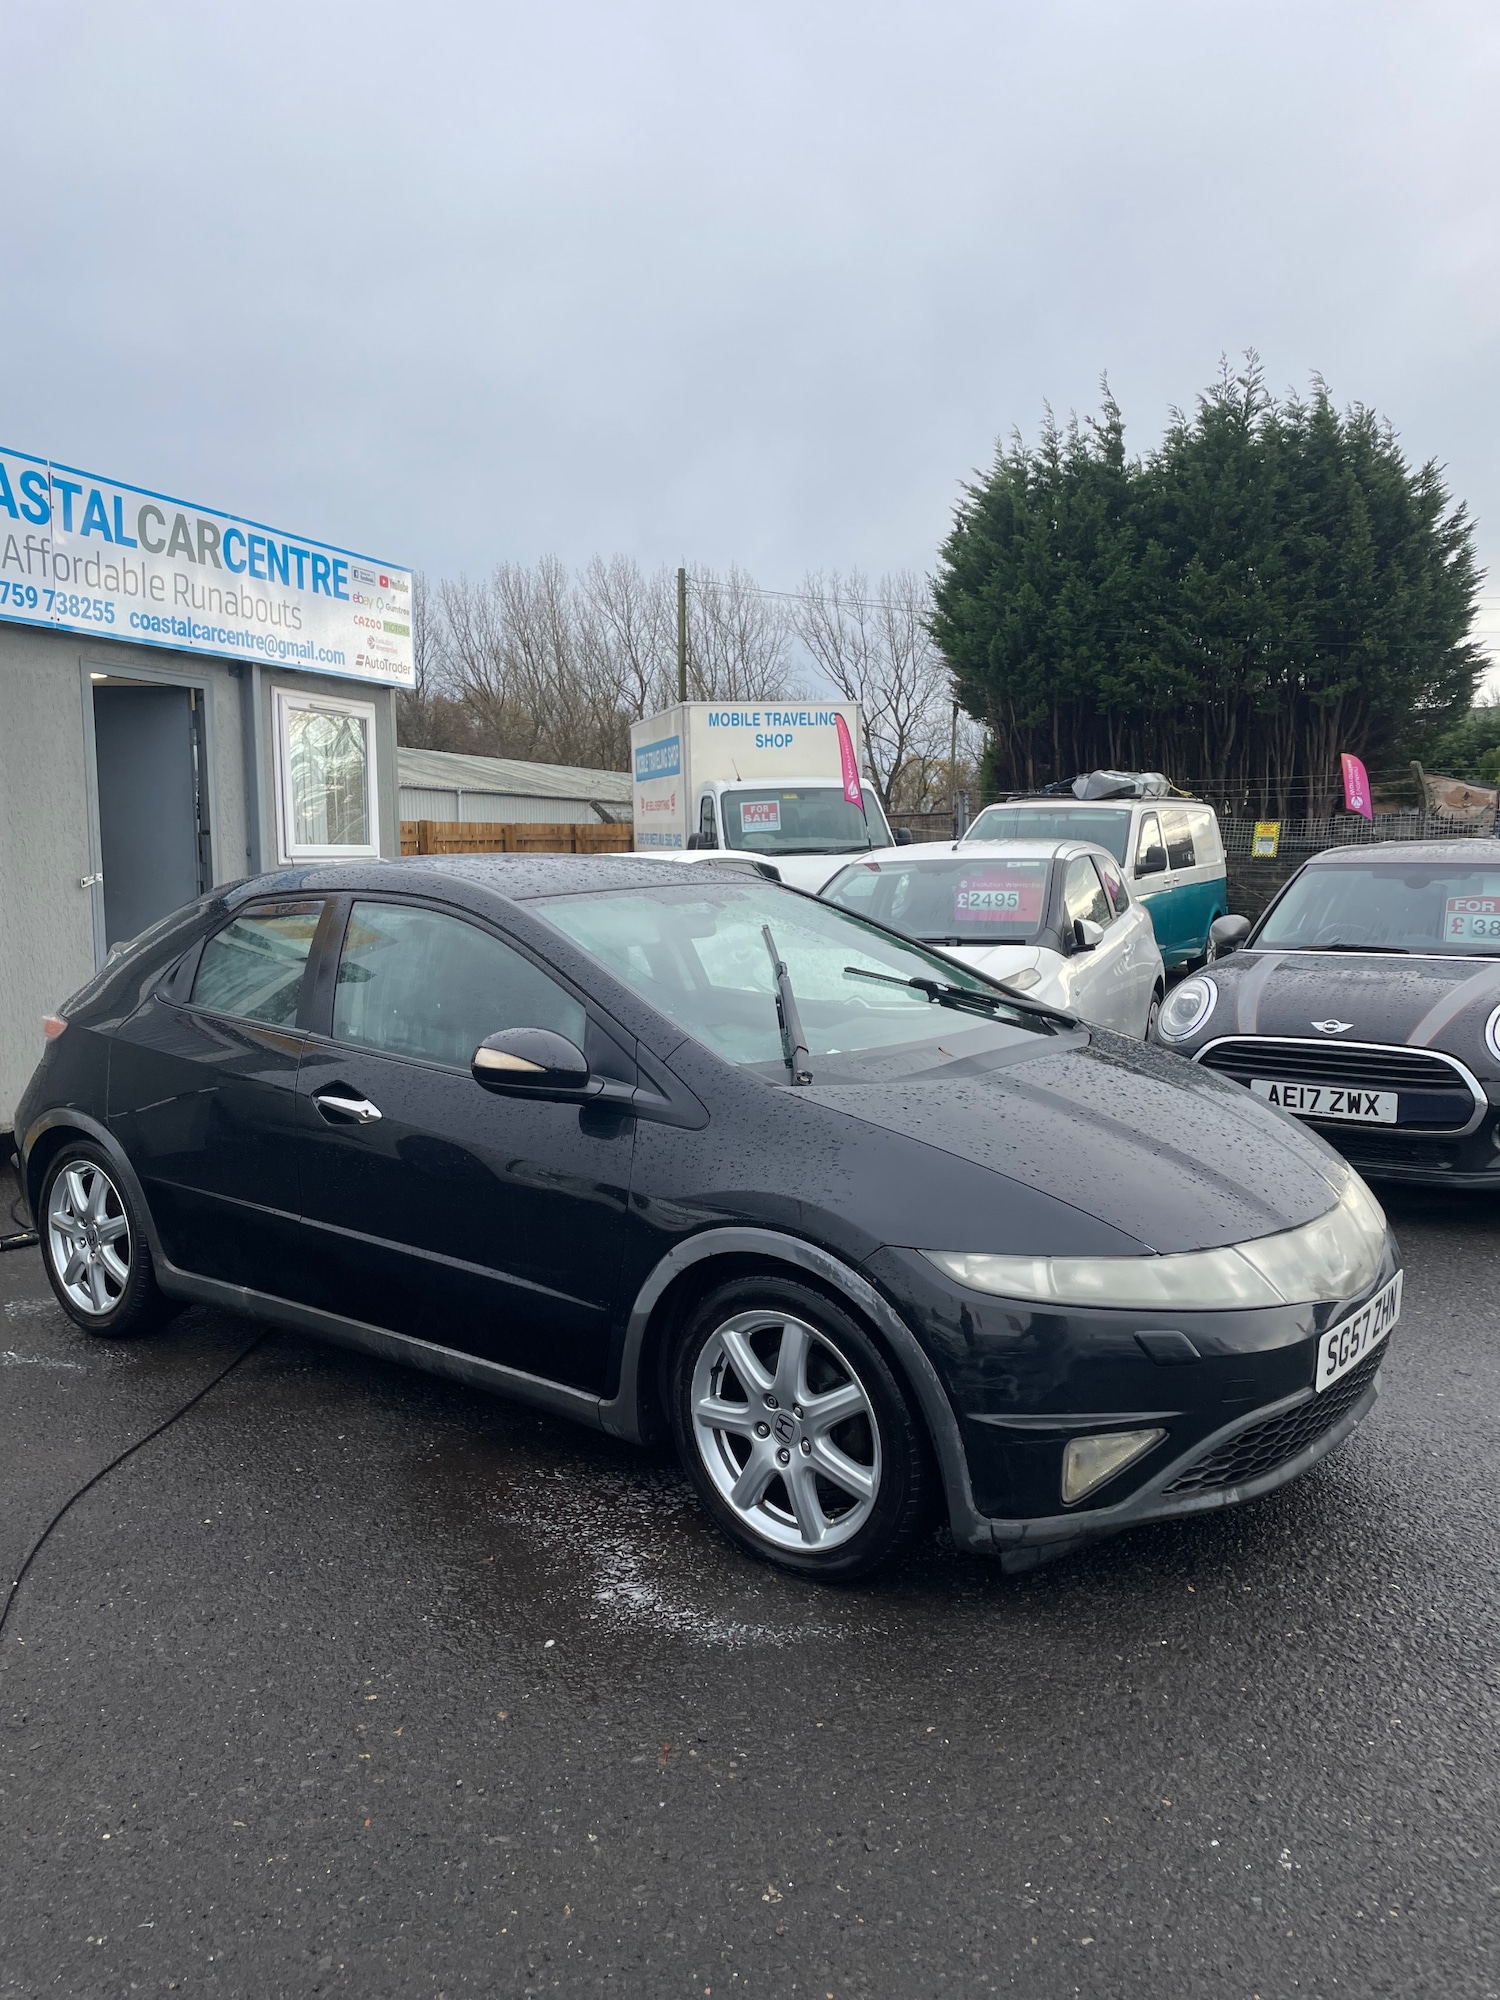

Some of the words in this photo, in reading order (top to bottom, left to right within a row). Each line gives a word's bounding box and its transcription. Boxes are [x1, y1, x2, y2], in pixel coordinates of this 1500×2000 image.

[2, 534, 164, 602] Affordable
[174, 573, 302, 630] Runabouts
[43, 588, 115, 624] 738255
[353, 591, 373, 609] ebay
[386, 603, 410, 616] Gumtree
[353, 615, 382, 630] CAZOO
[130, 612, 346, 665] coastalcarcentre@gmail.com
[365, 655, 412, 676] AutoTrader
[708, 712, 761, 727] MOBILE
[764, 711, 838, 727] TRAVELING
[755, 733, 793, 748] SHOP
[750, 805, 769, 813] FOR
[744, 813, 777, 823] SALE
[972, 881, 1004, 889] Evolution
[957, 893, 1018, 908] £2495
[1454, 900, 1496, 912] FOR
[1268, 1084, 1321, 1110] AE17
[1330, 1090, 1380, 1116] ZWX
[1326, 1308, 1371, 1376] SG57
[1373, 1281, 1398, 1339] ZHN
